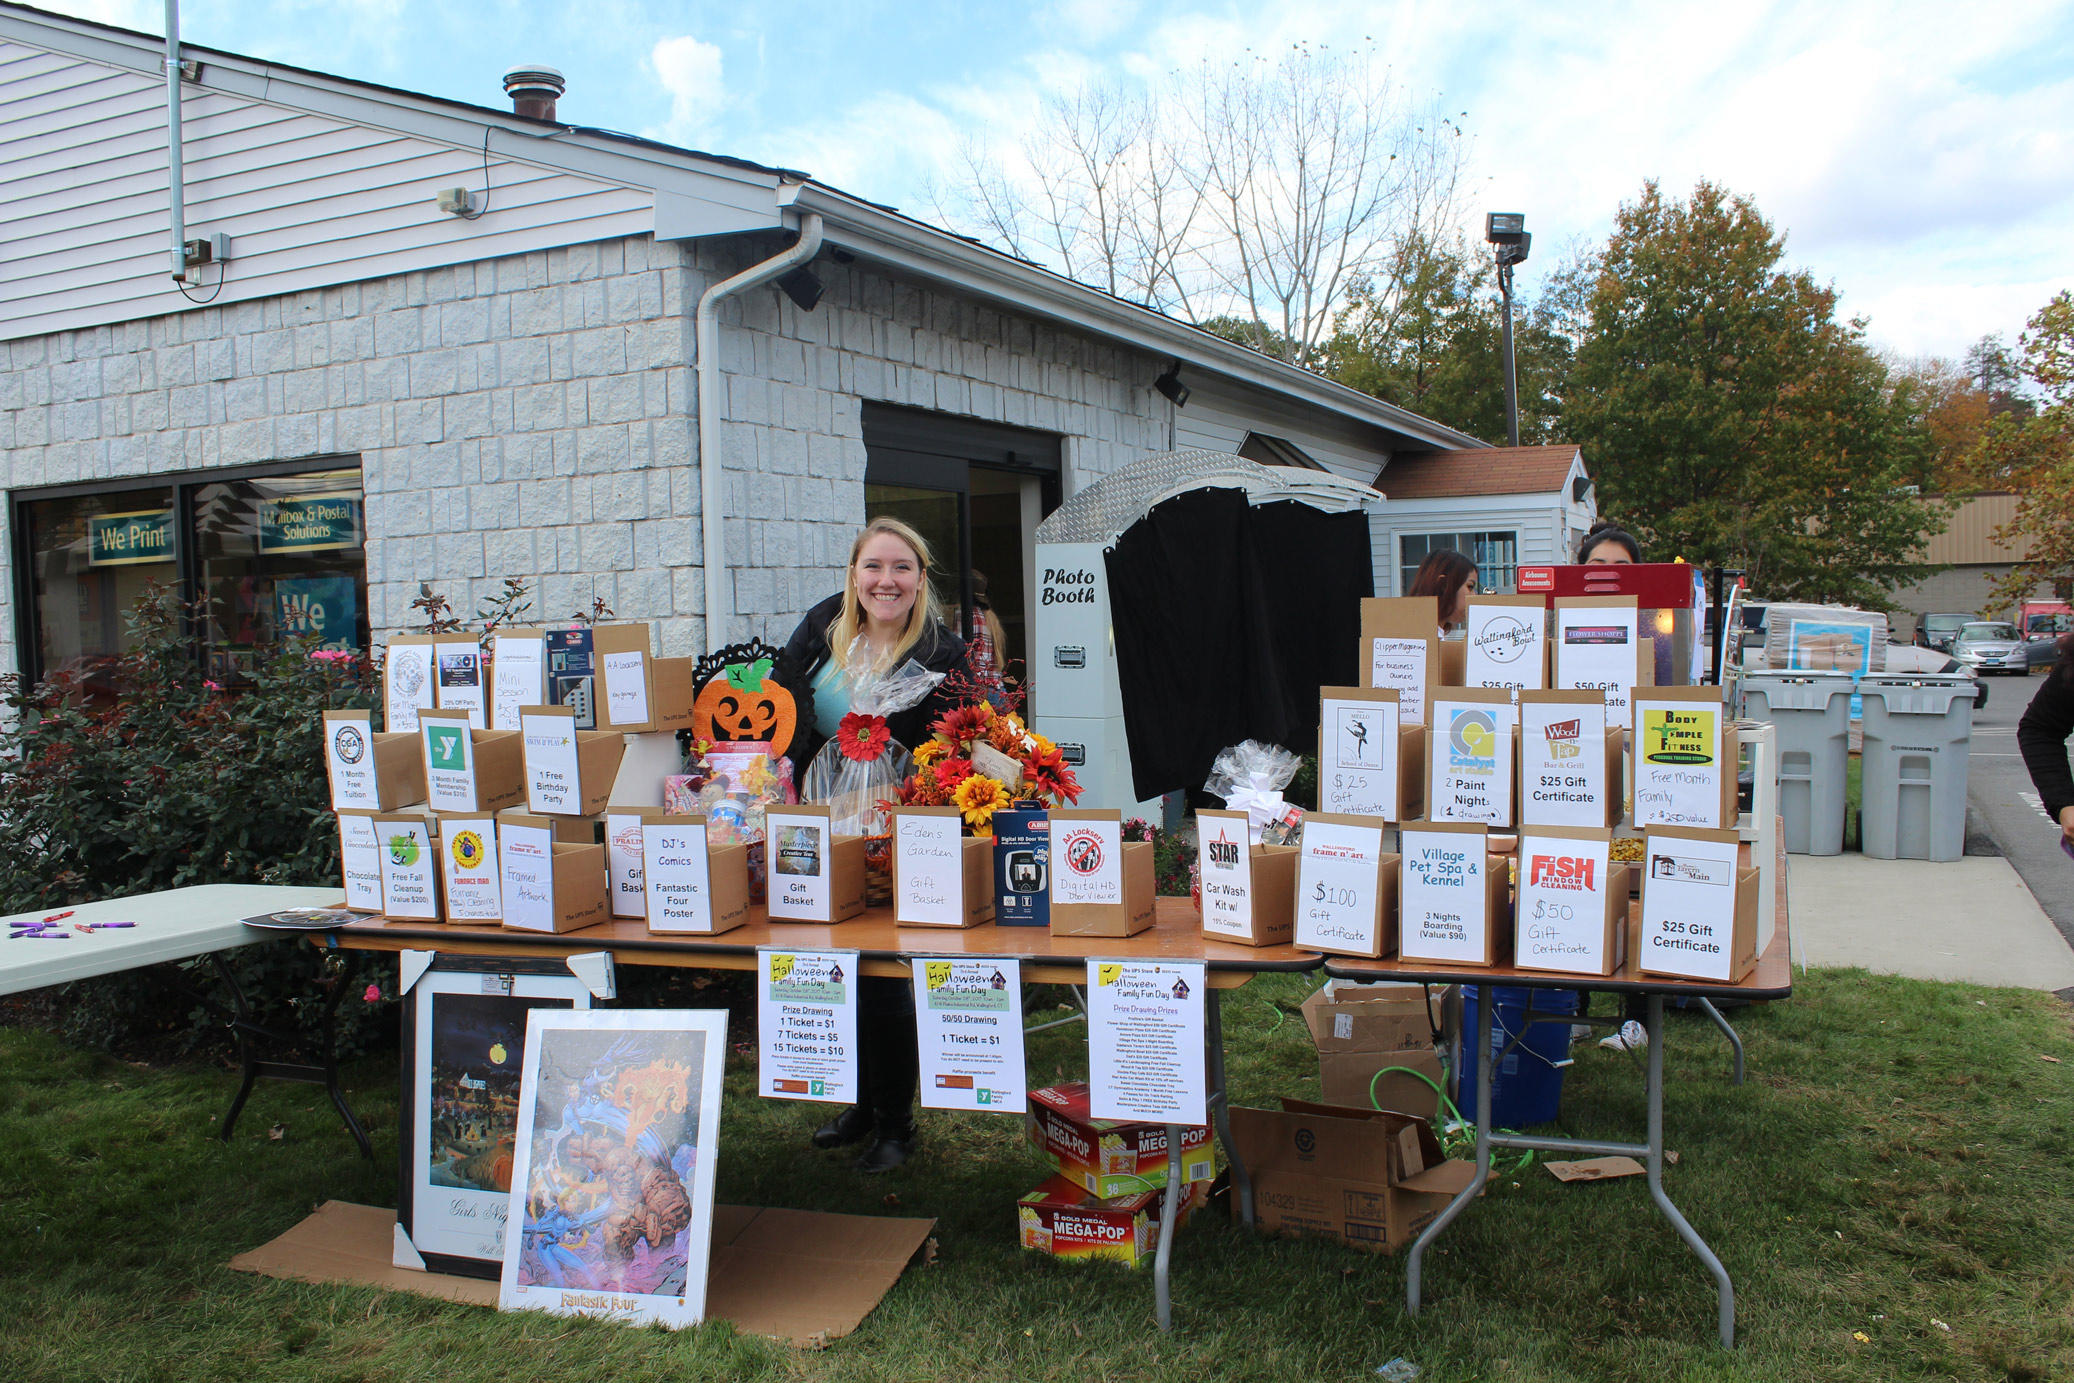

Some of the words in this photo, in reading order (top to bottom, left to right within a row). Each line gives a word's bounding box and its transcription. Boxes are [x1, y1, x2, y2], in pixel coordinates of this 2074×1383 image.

[307, 506, 316, 521] &
[318, 504, 349, 520] Postal
[101, 528, 125, 551] We
[130, 524, 165, 549] Print
[283, 525, 331, 541] Solutions
[1043, 568, 1095, 585] Photo
[1042, 587, 1095, 606] Booth
[281, 593, 325, 632] We
[1474, 623, 1534, 647] Wallingford
[1512, 632, 1537, 647] Bowl
[1504, 681, 1525, 692] Gift
[1598, 681, 1619, 692] Gift
[1547, 721, 1578, 740] Wood
[340, 739, 358, 748] CGA
[545, 771, 564, 780] Free
[1540, 775, 1562, 787] $25
[1564, 777, 1587, 788] Gift
[1651, 770, 1672, 785] Free
[536, 782, 569, 794] Birthday
[1455, 779, 1486, 791] Paint
[344, 790, 367, 798] Tuition
[543, 794, 563, 805] Party
[1532, 790, 1594, 803] Certificate
[900, 821, 943, 839] Eden's
[1072, 828, 1105, 845] Lockserv
[661, 839, 686, 849] DJ's
[906, 843, 954, 858] Garden
[1209, 842, 1239, 864] STAR
[1312, 847, 1338, 857] frame
[1422, 848, 1465, 864] Village
[658, 856, 692, 866] Comics
[628, 869, 643, 879] Gif
[1410, 860, 1432, 872] Pet
[1437, 863, 1463, 877] Spa
[1468, 863, 1478, 874] &
[346, 870, 381, 881] Chocolate
[392, 872, 408, 881] Free
[409, 873, 423, 881] Fall
[1422, 873, 1464, 887] Kennel
[1541, 876, 1582, 885] WINDOW
[1689, 872, 1710, 881] Main
[356, 883, 372, 894] Tray
[621, 883, 644, 893] Bask
[656, 883, 698, 893] Fantastic
[789, 882, 807, 893] Gift
[910, 876, 936, 889] Gift
[1060, 878, 1098, 892] Digital
[1100, 881, 1116, 890] HD
[1540, 882, 1583, 891] CLEANING
[393, 884, 424, 895] Cleanup
[1206, 882, 1221, 894] Car
[1222, 884, 1246, 897] Wash
[1312, 880, 1357, 908] $100
[667, 896, 689, 906] Four
[783, 895, 814, 906] Basket
[911, 892, 945, 905] Basket
[1215, 899, 1227, 911] Kit
[664, 908, 694, 918] Poster
[1309, 908, 1331, 921] Gift
[1531, 899, 1574, 921] $50
[1425, 912, 1431, 920] 3
[1432, 912, 1461, 922] Nights
[1316, 923, 1366, 941] Certificate
[1423, 921, 1463, 932] Boarding
[1528, 924, 1561, 940] Gift
[1662, 920, 1685, 933] $25
[1689, 923, 1713, 937] Gift
[1419, 930, 1446, 940] (Value
[1448, 931, 1467, 942] $90)
[1532, 943, 1591, 956] Certificate
[1653, 935, 1720, 954] Certificate
[773, 963, 829, 977] Halloween
[773, 976, 796, 989] Family
[796, 977, 810, 987] Fun
[810, 977, 825, 990] Day
[929, 971, 991, 984] Halloween
[1107, 977, 1157, 989] Halloween
[931, 983, 955, 996] Family
[955, 984, 970, 994] Fun
[971, 984, 987, 997] Day
[1117, 988, 1140, 1000] Family
[1141, 989, 1155, 999] Fun
[1155, 990, 1170, 1001] Day
[782, 1005, 801, 1015] Prize
[802, 1006, 833, 1017] Drawing
[1130, 1004, 1157, 1016] Drawing
[787, 1017, 815, 1028] Ticket
[824, 1019, 835, 1030] $1
[942, 1014, 963, 1024] 50/50
[964, 1015, 998, 1026] Drawing
[777, 1029, 784, 1039] 7
[786, 1030, 818, 1042] Tickets
[827, 1032, 839, 1043] $5
[949, 1034, 979, 1045] Ticket
[989, 1035, 1000, 1046] $1
[774, 1043, 784, 1053] 15
[786, 1043, 818, 1055] Tickets
[828, 1046, 844, 1056] $10
[1047, 1122, 1090, 1158] MEGA-POP
[1145, 1130, 1165, 1138] GOLD
[1061, 1216, 1081, 1224] GOLD
[1082, 1217, 1108, 1226] MEDAL
[1053, 1221, 1126, 1240] MEGA-POP
[560, 1291, 609, 1309] Fantastic
